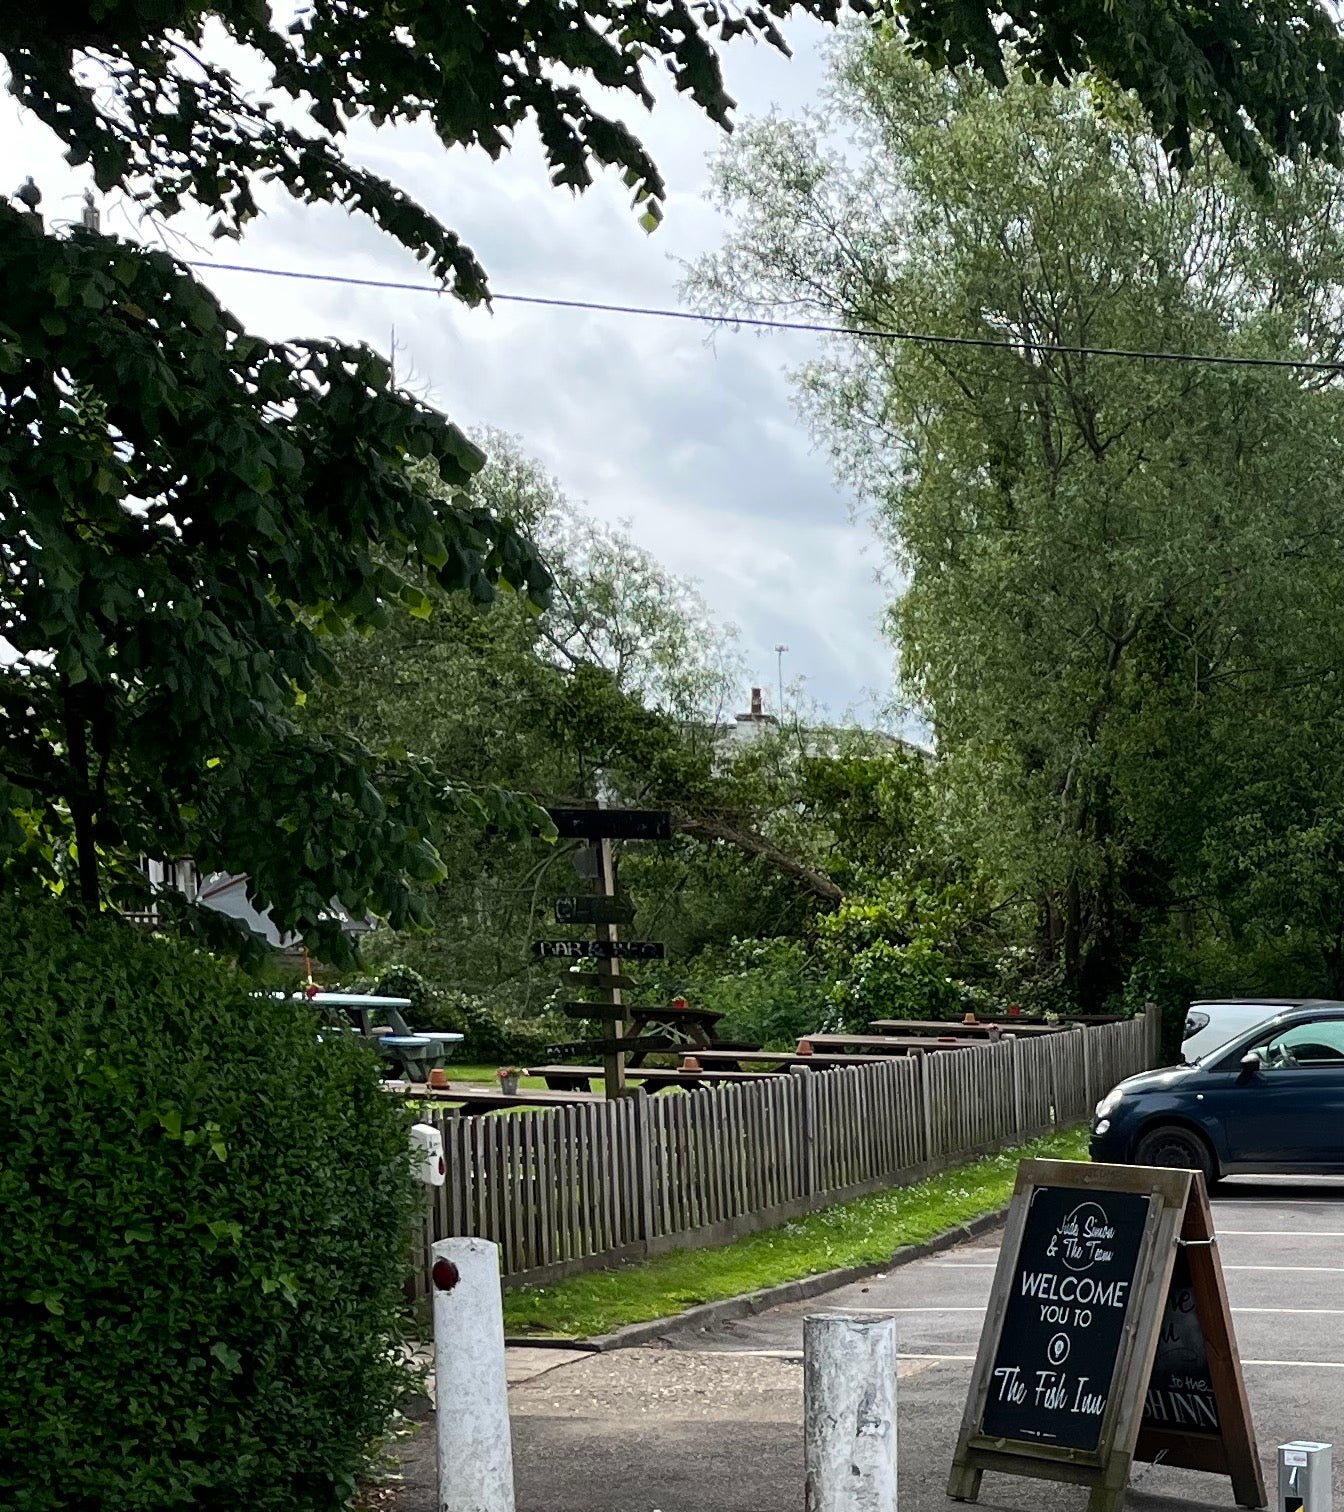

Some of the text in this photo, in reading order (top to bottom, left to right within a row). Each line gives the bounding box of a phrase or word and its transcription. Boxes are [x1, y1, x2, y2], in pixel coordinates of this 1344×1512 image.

[1082, 1215, 1116, 1239] Simon
[1046, 1234, 1115, 1261] & The Team
[1021, 1270, 1129, 1308] WELCOME
[1040, 1304, 1092, 1328] YOU TO
[994, 1366, 1107, 1415] The Fish Inn
[1168, 1391, 1219, 1428] INN
